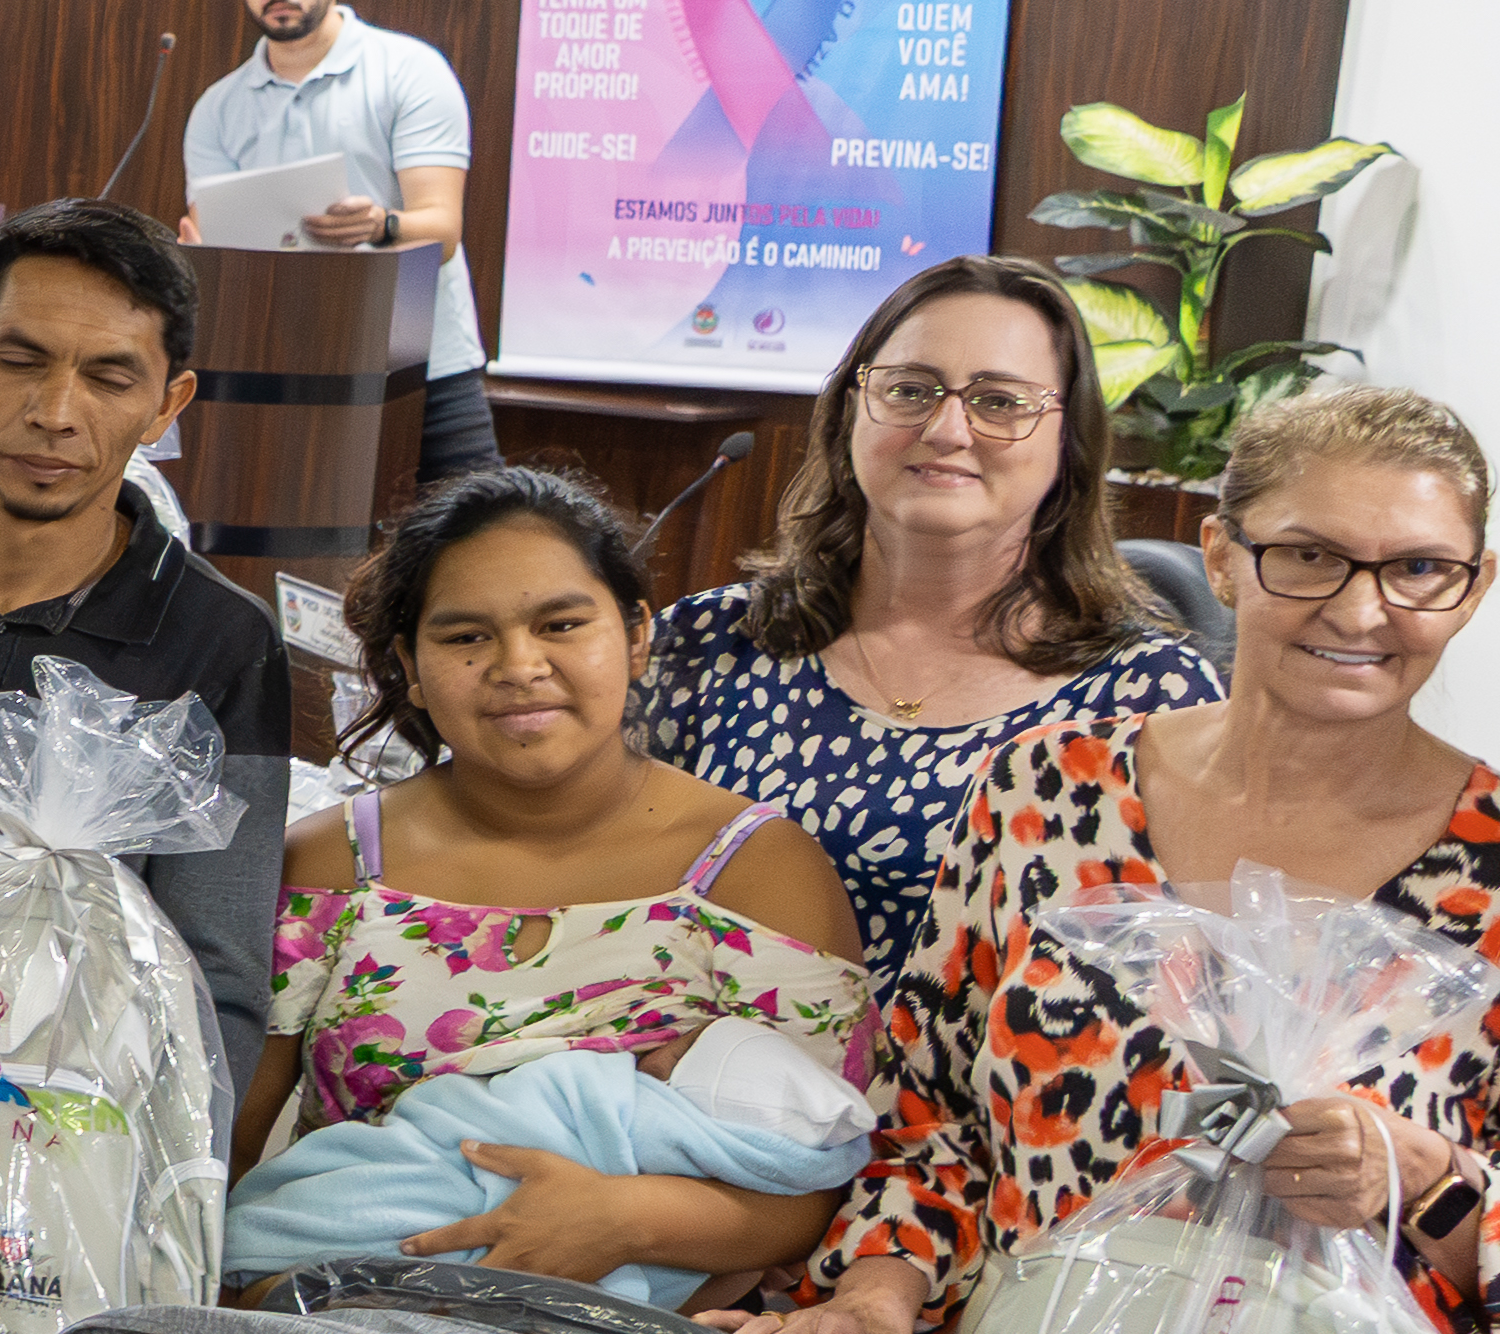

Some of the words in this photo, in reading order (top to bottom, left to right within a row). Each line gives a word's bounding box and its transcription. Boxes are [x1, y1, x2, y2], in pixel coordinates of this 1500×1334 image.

[539, 12, 608, 40] TOQUE
[614, 13, 643, 41] DE
[897, 3, 973, 33] QUEM
[555, 42, 621, 70] AMOR
[898, 32, 968, 67] VOCÊ
[533, 65, 639, 101] PRÓPRIO!
[899, 73, 969, 102] AMA!
[528, 131, 637, 162] CUIDE-SE!
[830, 138, 990, 171] PREVINA-SE!
[614, 198, 698, 223] ESTAMOS
[703, 202, 774, 226] JUNTOS
[778, 204, 827, 228] PELA
[607, 235, 622, 260] A
[626, 233, 741, 269] PREVENÇÃO
[745, 235, 760, 266] É
[763, 241, 778, 267] O
[783, 242, 882, 271] CAMINHO!
